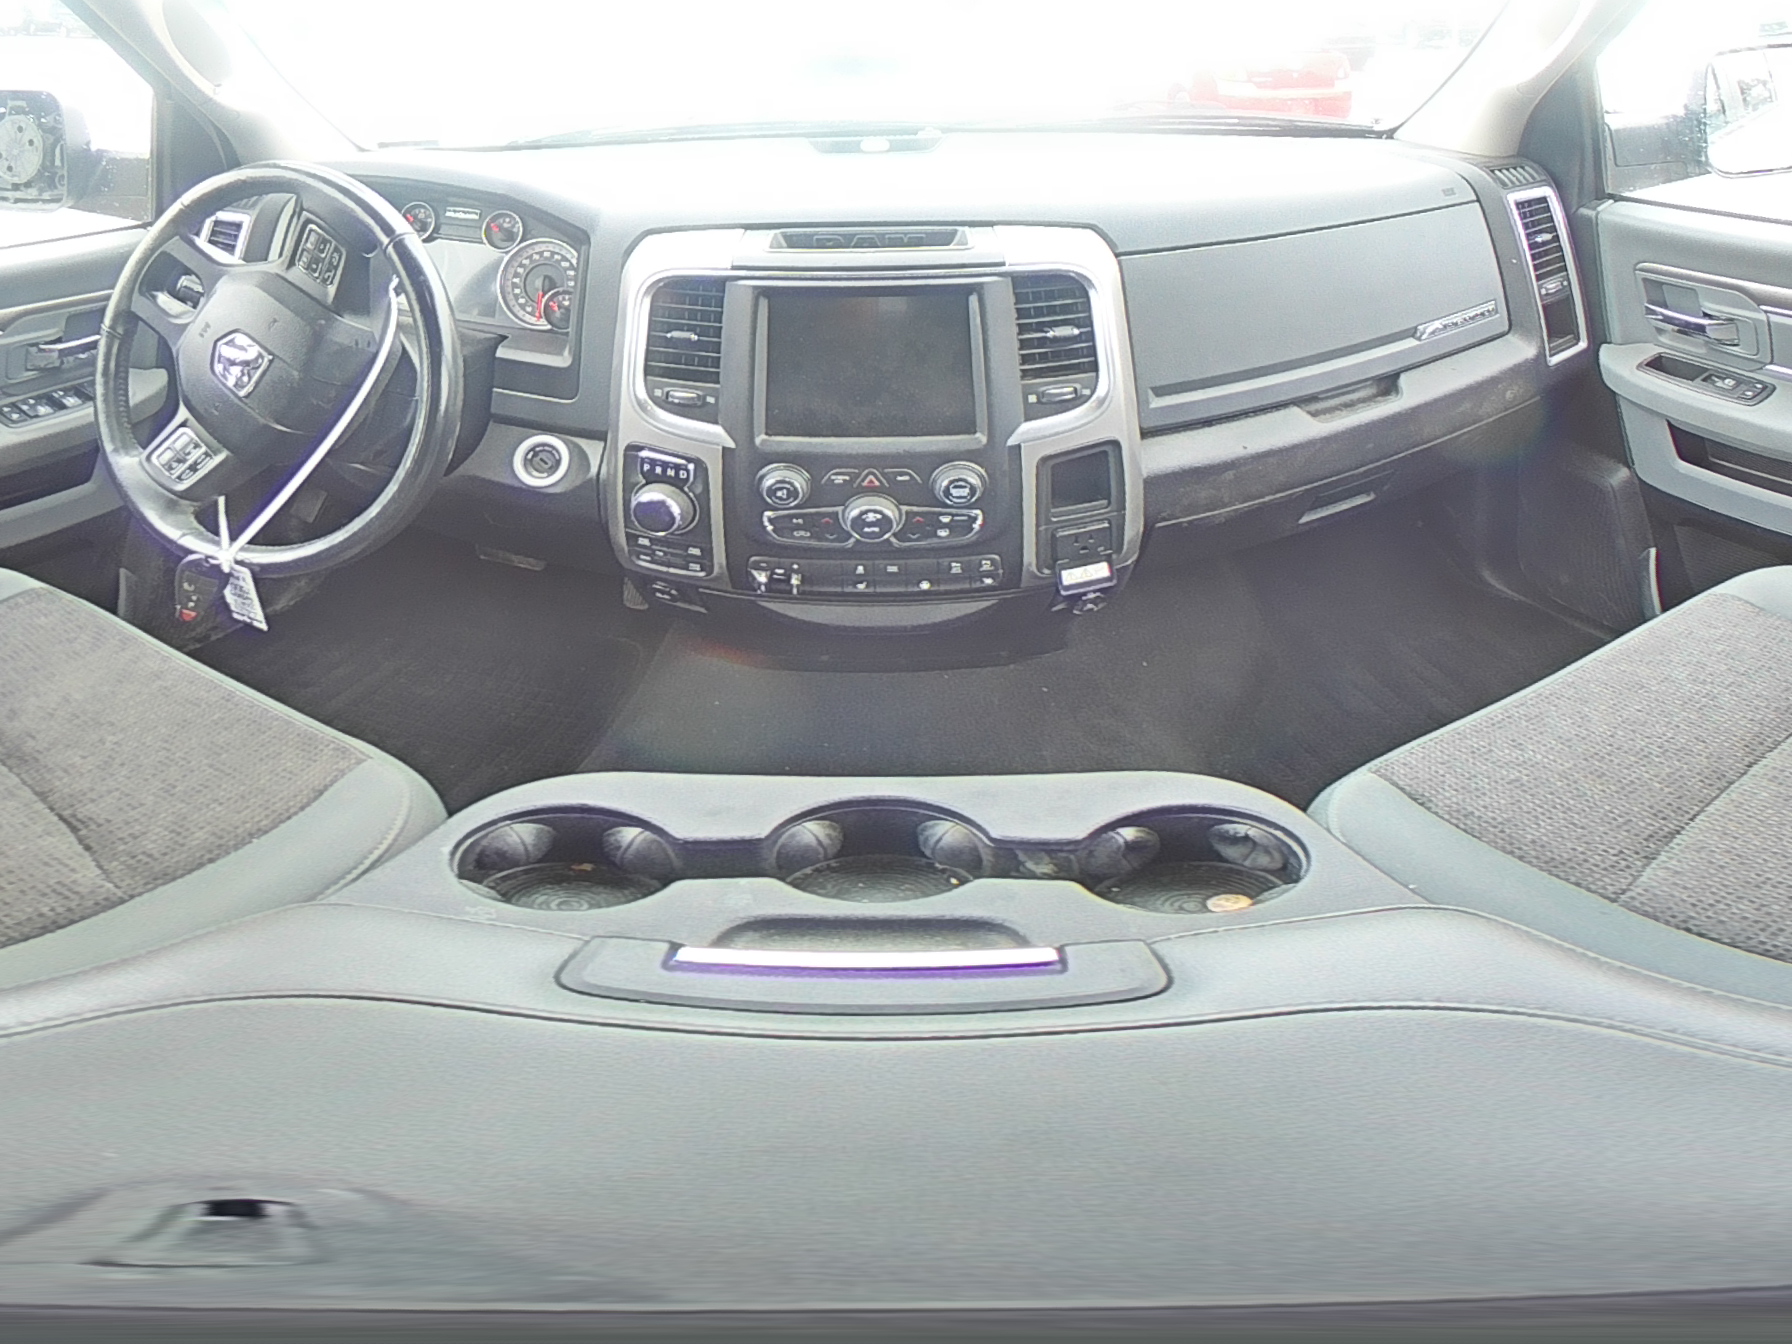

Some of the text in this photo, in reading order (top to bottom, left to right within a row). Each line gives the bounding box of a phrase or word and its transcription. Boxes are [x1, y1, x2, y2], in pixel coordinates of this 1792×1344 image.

[643, 462, 651, 472] P
[655, 465, 663, 476] R
[679, 469, 688, 479] D
